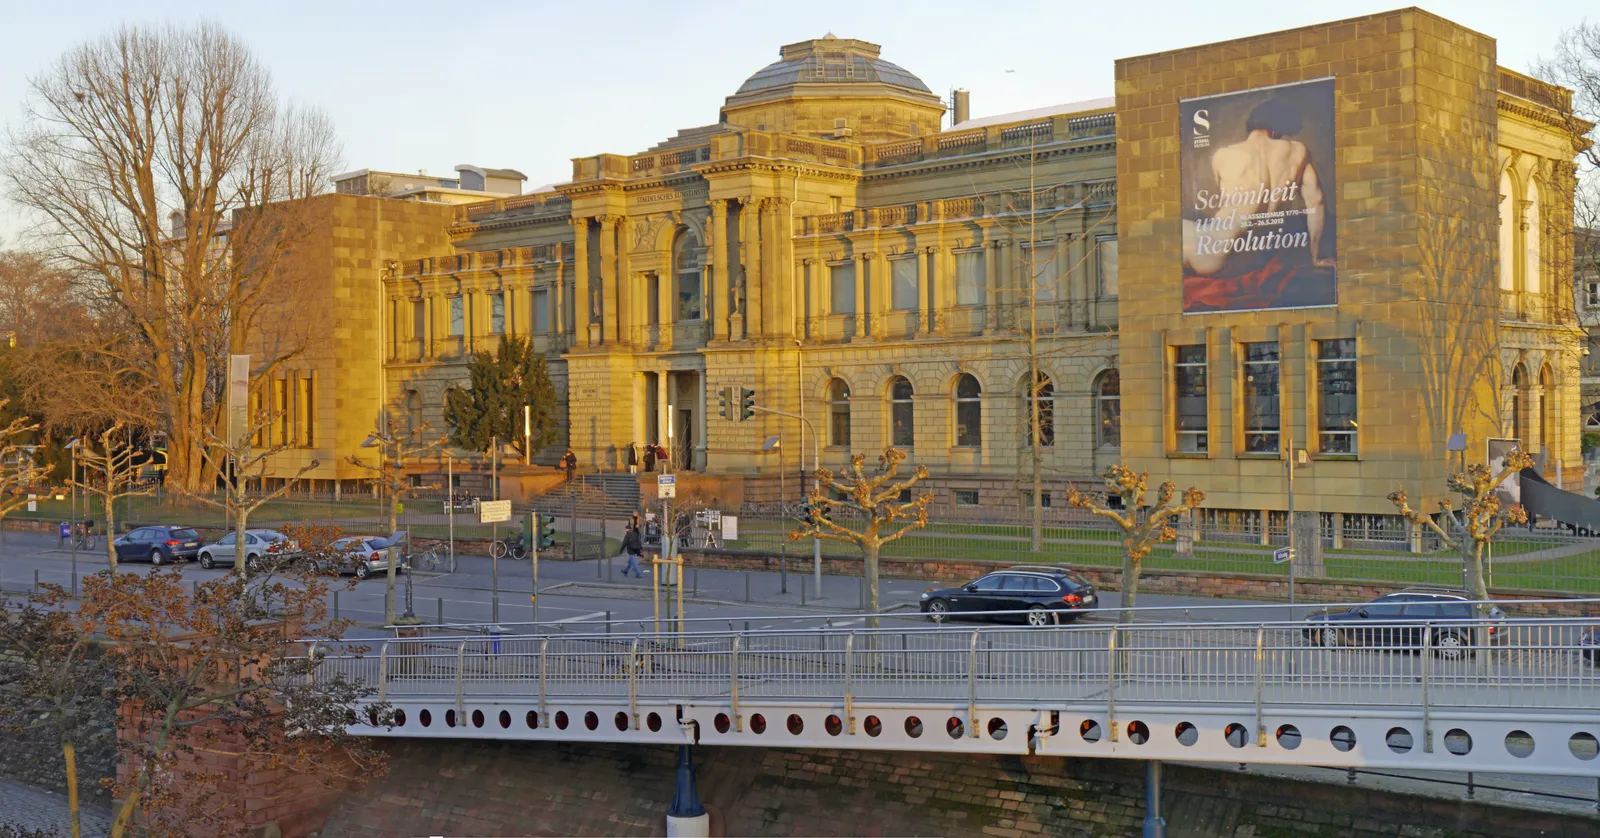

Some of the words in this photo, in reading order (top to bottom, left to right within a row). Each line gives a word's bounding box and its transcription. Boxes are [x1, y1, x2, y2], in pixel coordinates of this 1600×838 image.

[1193, 109, 1210, 135] S
[1195, 180, 1298, 210] Schönheit
[1195, 208, 1236, 233] und
[1196, 228, 1308, 256] Revolution
